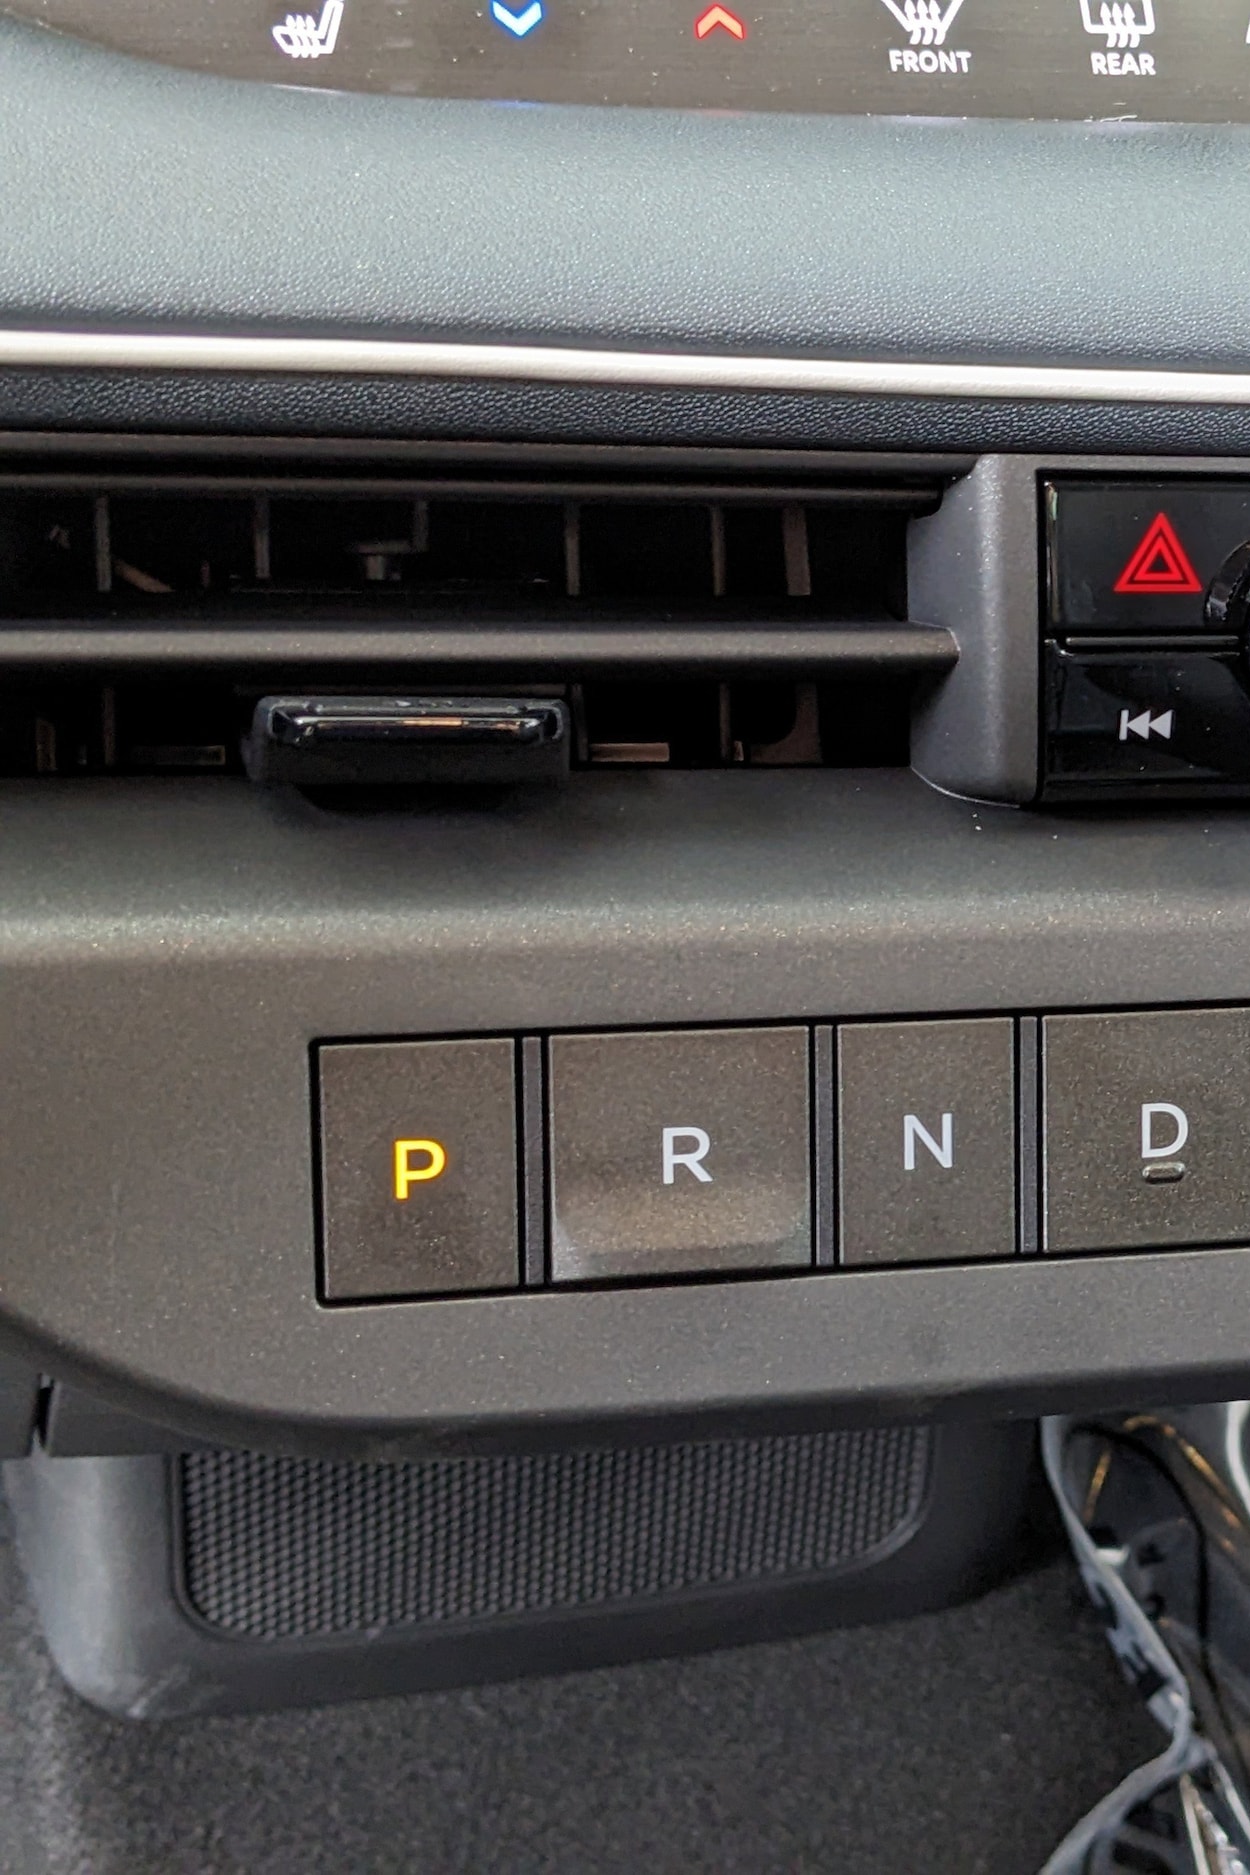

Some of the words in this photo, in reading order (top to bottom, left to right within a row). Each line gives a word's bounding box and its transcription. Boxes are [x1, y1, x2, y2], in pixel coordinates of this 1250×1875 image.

[889, 50, 971, 73] FRONT
[1090, 53, 1156, 75] REAR
[662, 1126, 712, 1184] R
[904, 1113, 953, 1170] N
[1141, 1102, 1188, 1159] D
[394, 1138, 447, 1198] P
